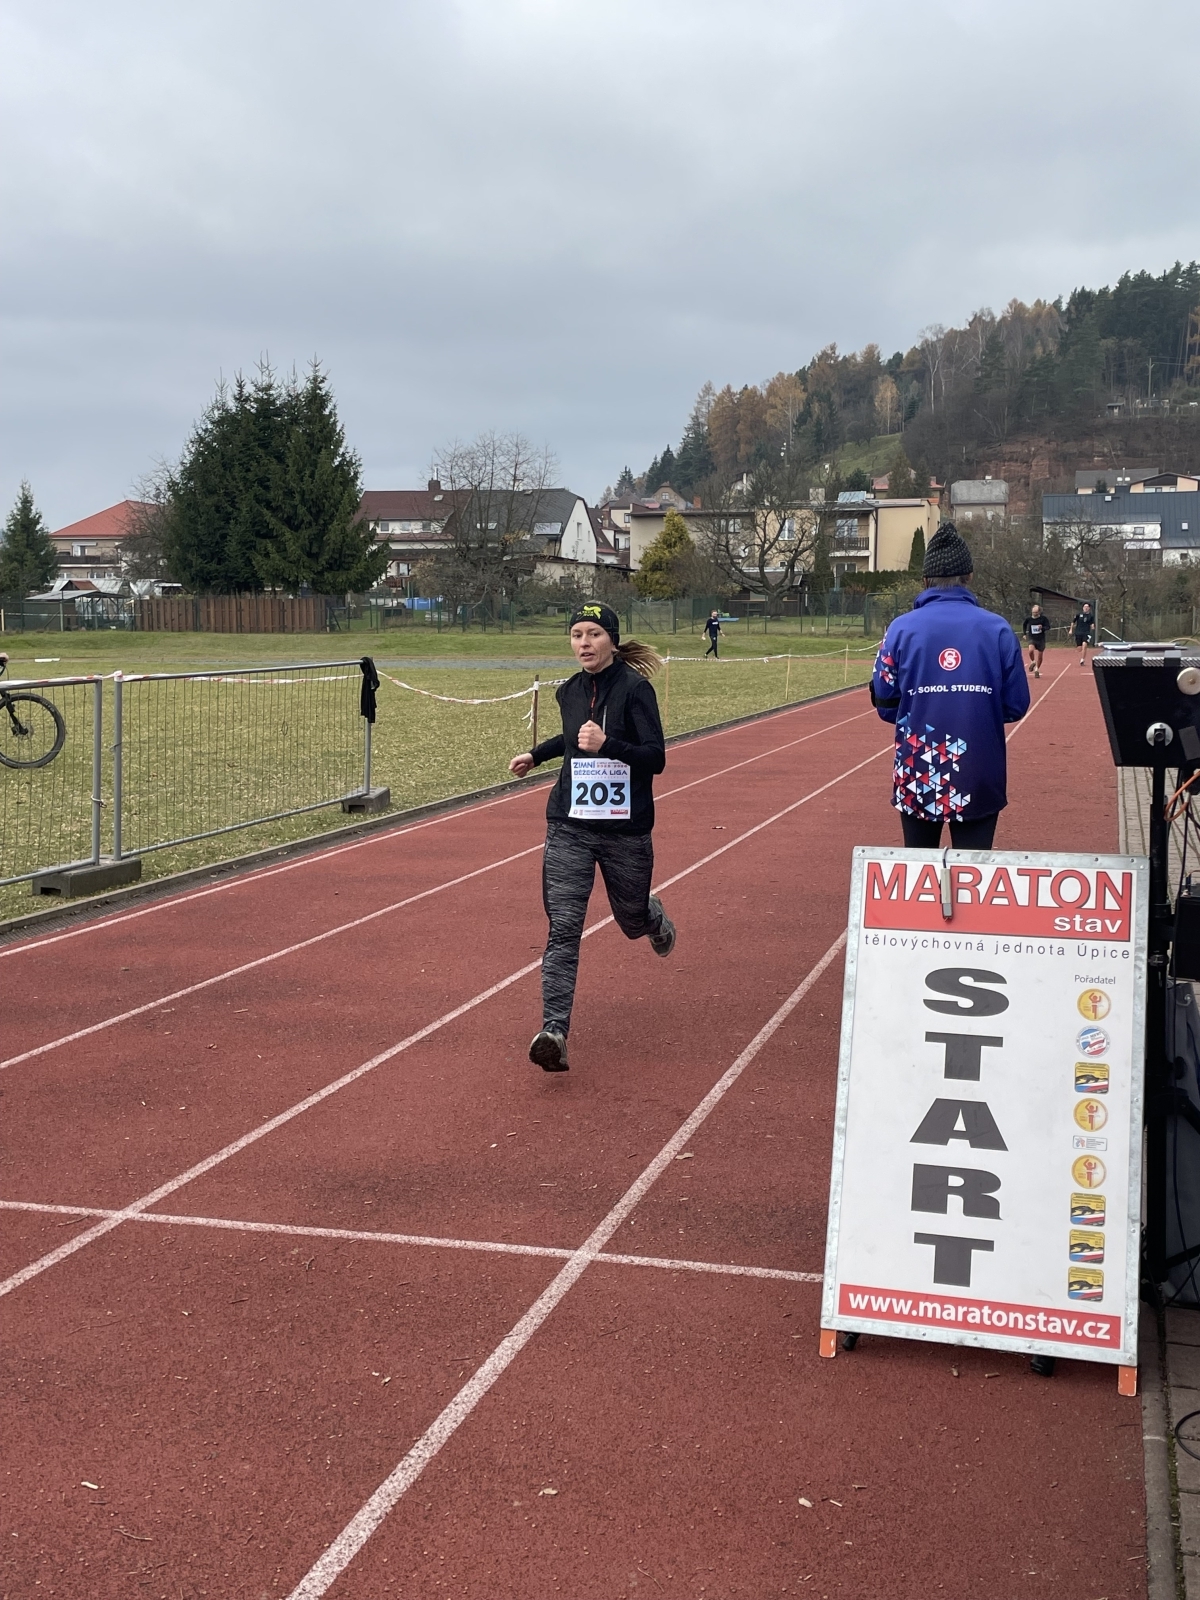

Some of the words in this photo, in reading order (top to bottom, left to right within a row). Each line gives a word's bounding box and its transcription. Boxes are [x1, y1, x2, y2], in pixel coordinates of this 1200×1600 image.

[918, 685, 949, 693] SOKOL
[575, 782, 626, 806] 203
[866, 862, 1133, 912] MARATON
[1053, 914, 1123, 934] stav
[864, 934, 985, 952] tělovýchovná
[994, 940, 1066, 957] jednota
[1076, 943, 1131, 959] Úpice
[1074, 974, 1116, 985] Pořadatel
[909, 967, 1010, 1288] START
[848, 1292, 1112, 1340] www.maratonstav.cz
